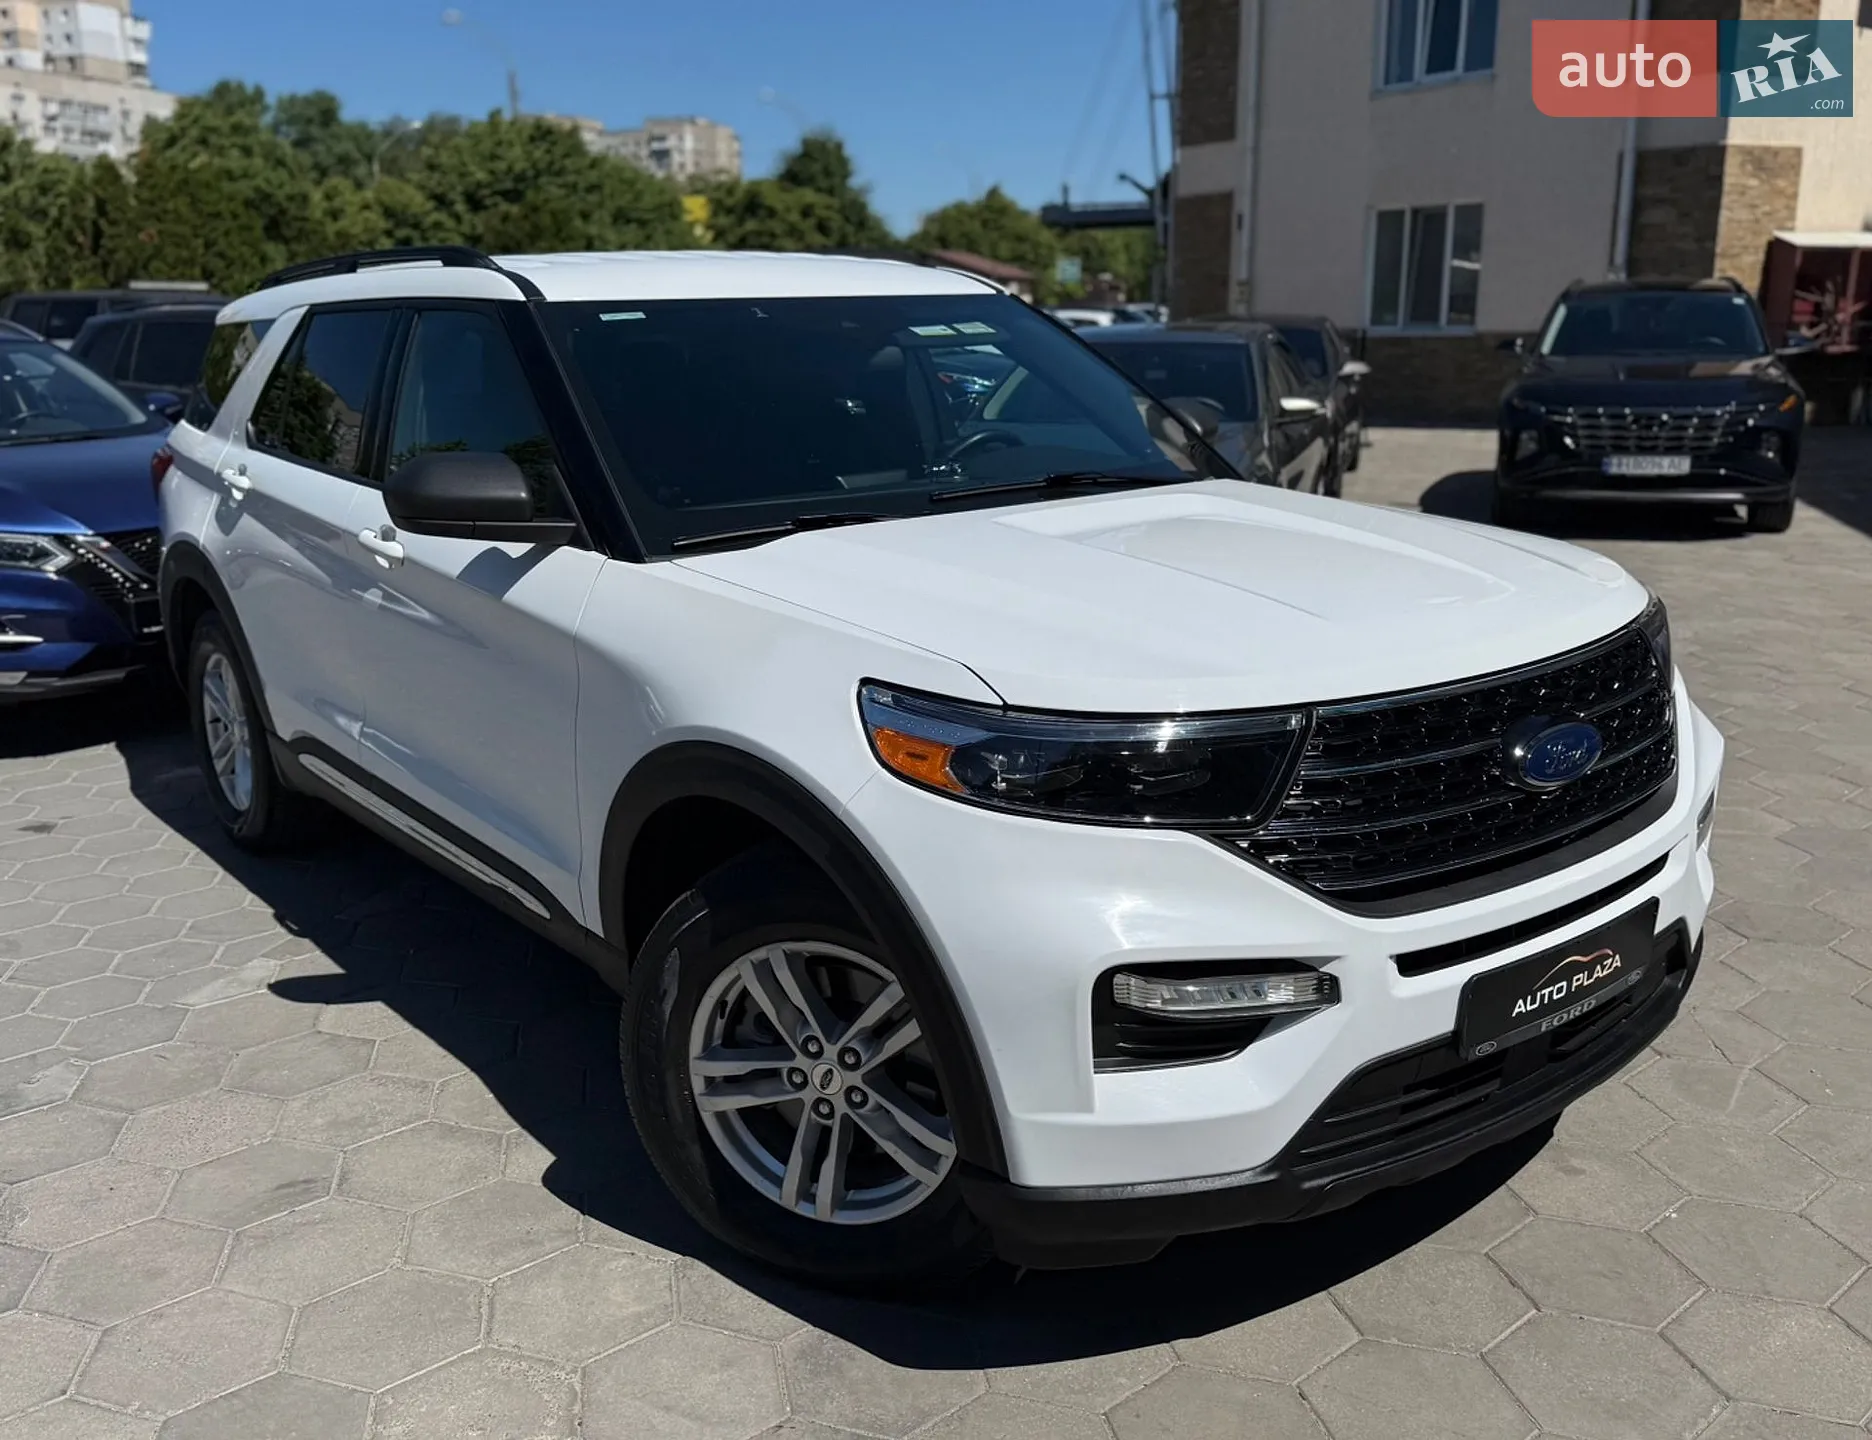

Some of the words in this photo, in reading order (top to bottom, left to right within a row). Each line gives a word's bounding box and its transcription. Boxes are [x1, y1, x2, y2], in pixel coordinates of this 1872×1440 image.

[1511, 980, 1568, 1017] AUTO
[1571, 953, 1622, 992] PLAZA
[1540, 999, 1596, 1032] FORD
